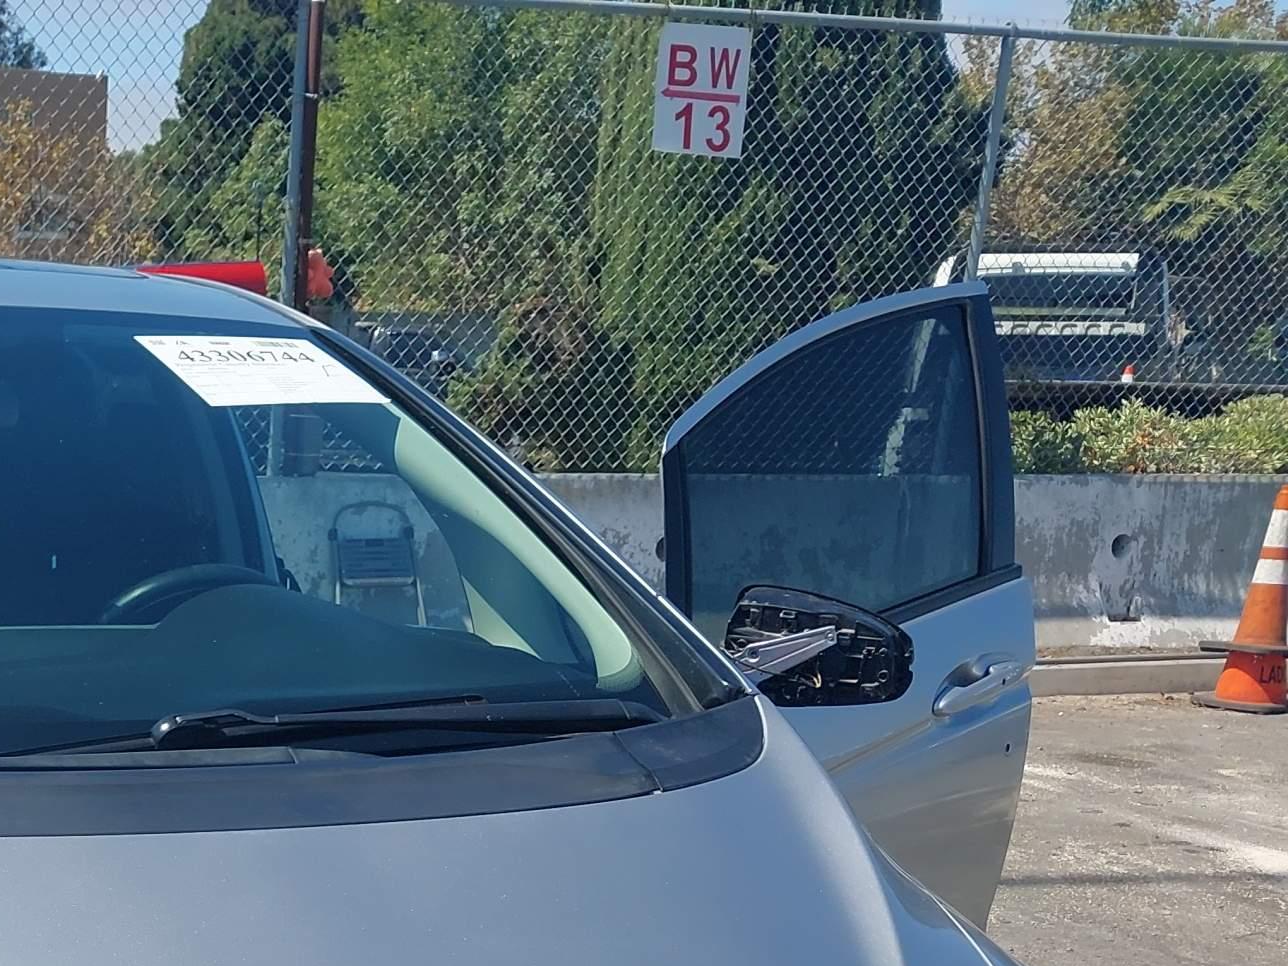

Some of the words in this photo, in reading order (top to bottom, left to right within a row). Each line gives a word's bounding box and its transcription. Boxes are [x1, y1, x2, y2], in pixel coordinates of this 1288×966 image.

[667, 44, 742, 90] BW
[675, 102, 731, 152] 13
[177, 350, 315, 363] 43306744
